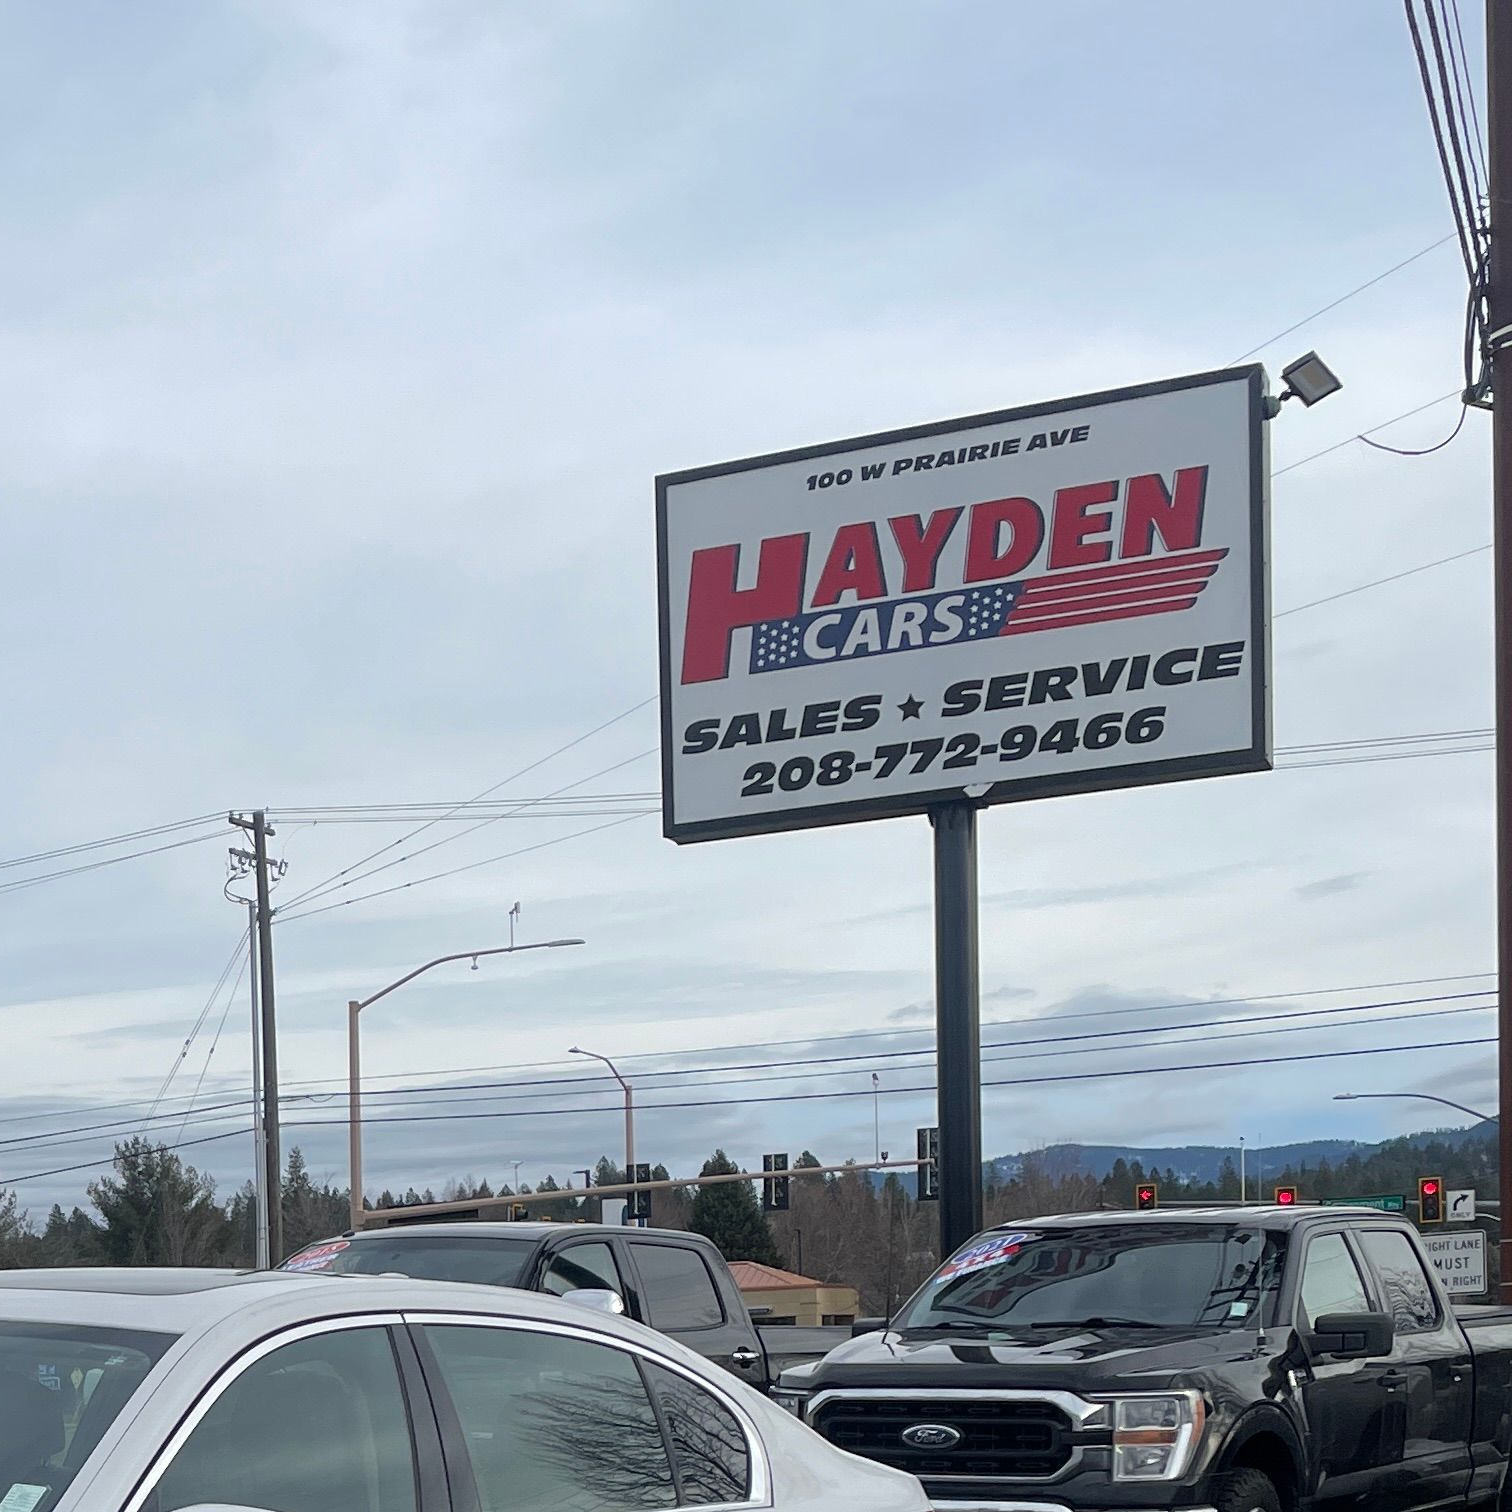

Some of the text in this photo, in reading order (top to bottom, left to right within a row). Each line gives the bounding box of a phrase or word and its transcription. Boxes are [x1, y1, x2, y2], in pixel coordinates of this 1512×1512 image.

[806, 425, 1090, 491] 100 W PRAIRIE AVE
[680, 464, 1209, 685] HAYDEN
[803, 594, 966, 660] CARS
[682, 641, 1246, 755] SALES SERVICE
[740, 706, 1168, 797] 208-772-9466
[1425, 1239, 1481, 1251] IGHT LANE
[1434, 1256, 1470, 1270] MUST
[1452, 1274, 1482, 1286] RIGHT
[914, 1429, 947, 1444] Ford
